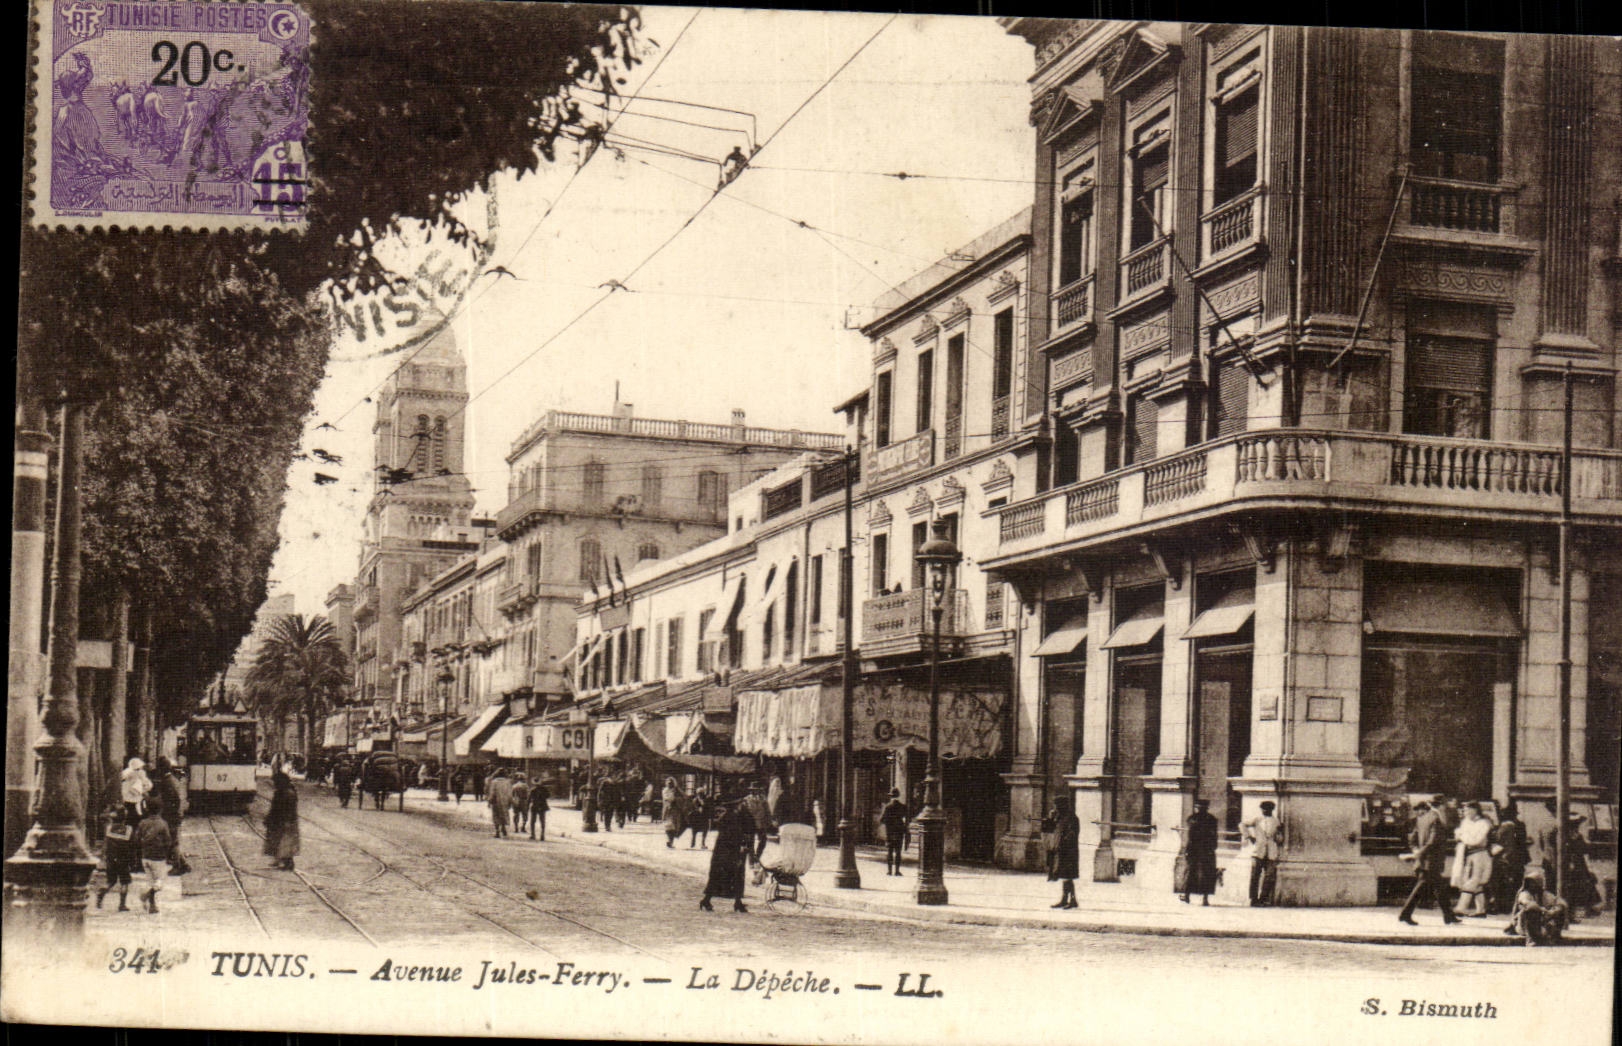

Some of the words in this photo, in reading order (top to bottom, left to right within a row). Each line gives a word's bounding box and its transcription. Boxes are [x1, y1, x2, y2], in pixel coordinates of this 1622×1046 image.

[72, 12, 95, 32] RF
[106, 4, 181, 28] TUNISIE
[194, 7, 267, 29] POSTES
[253, 162, 303, 212] 15
